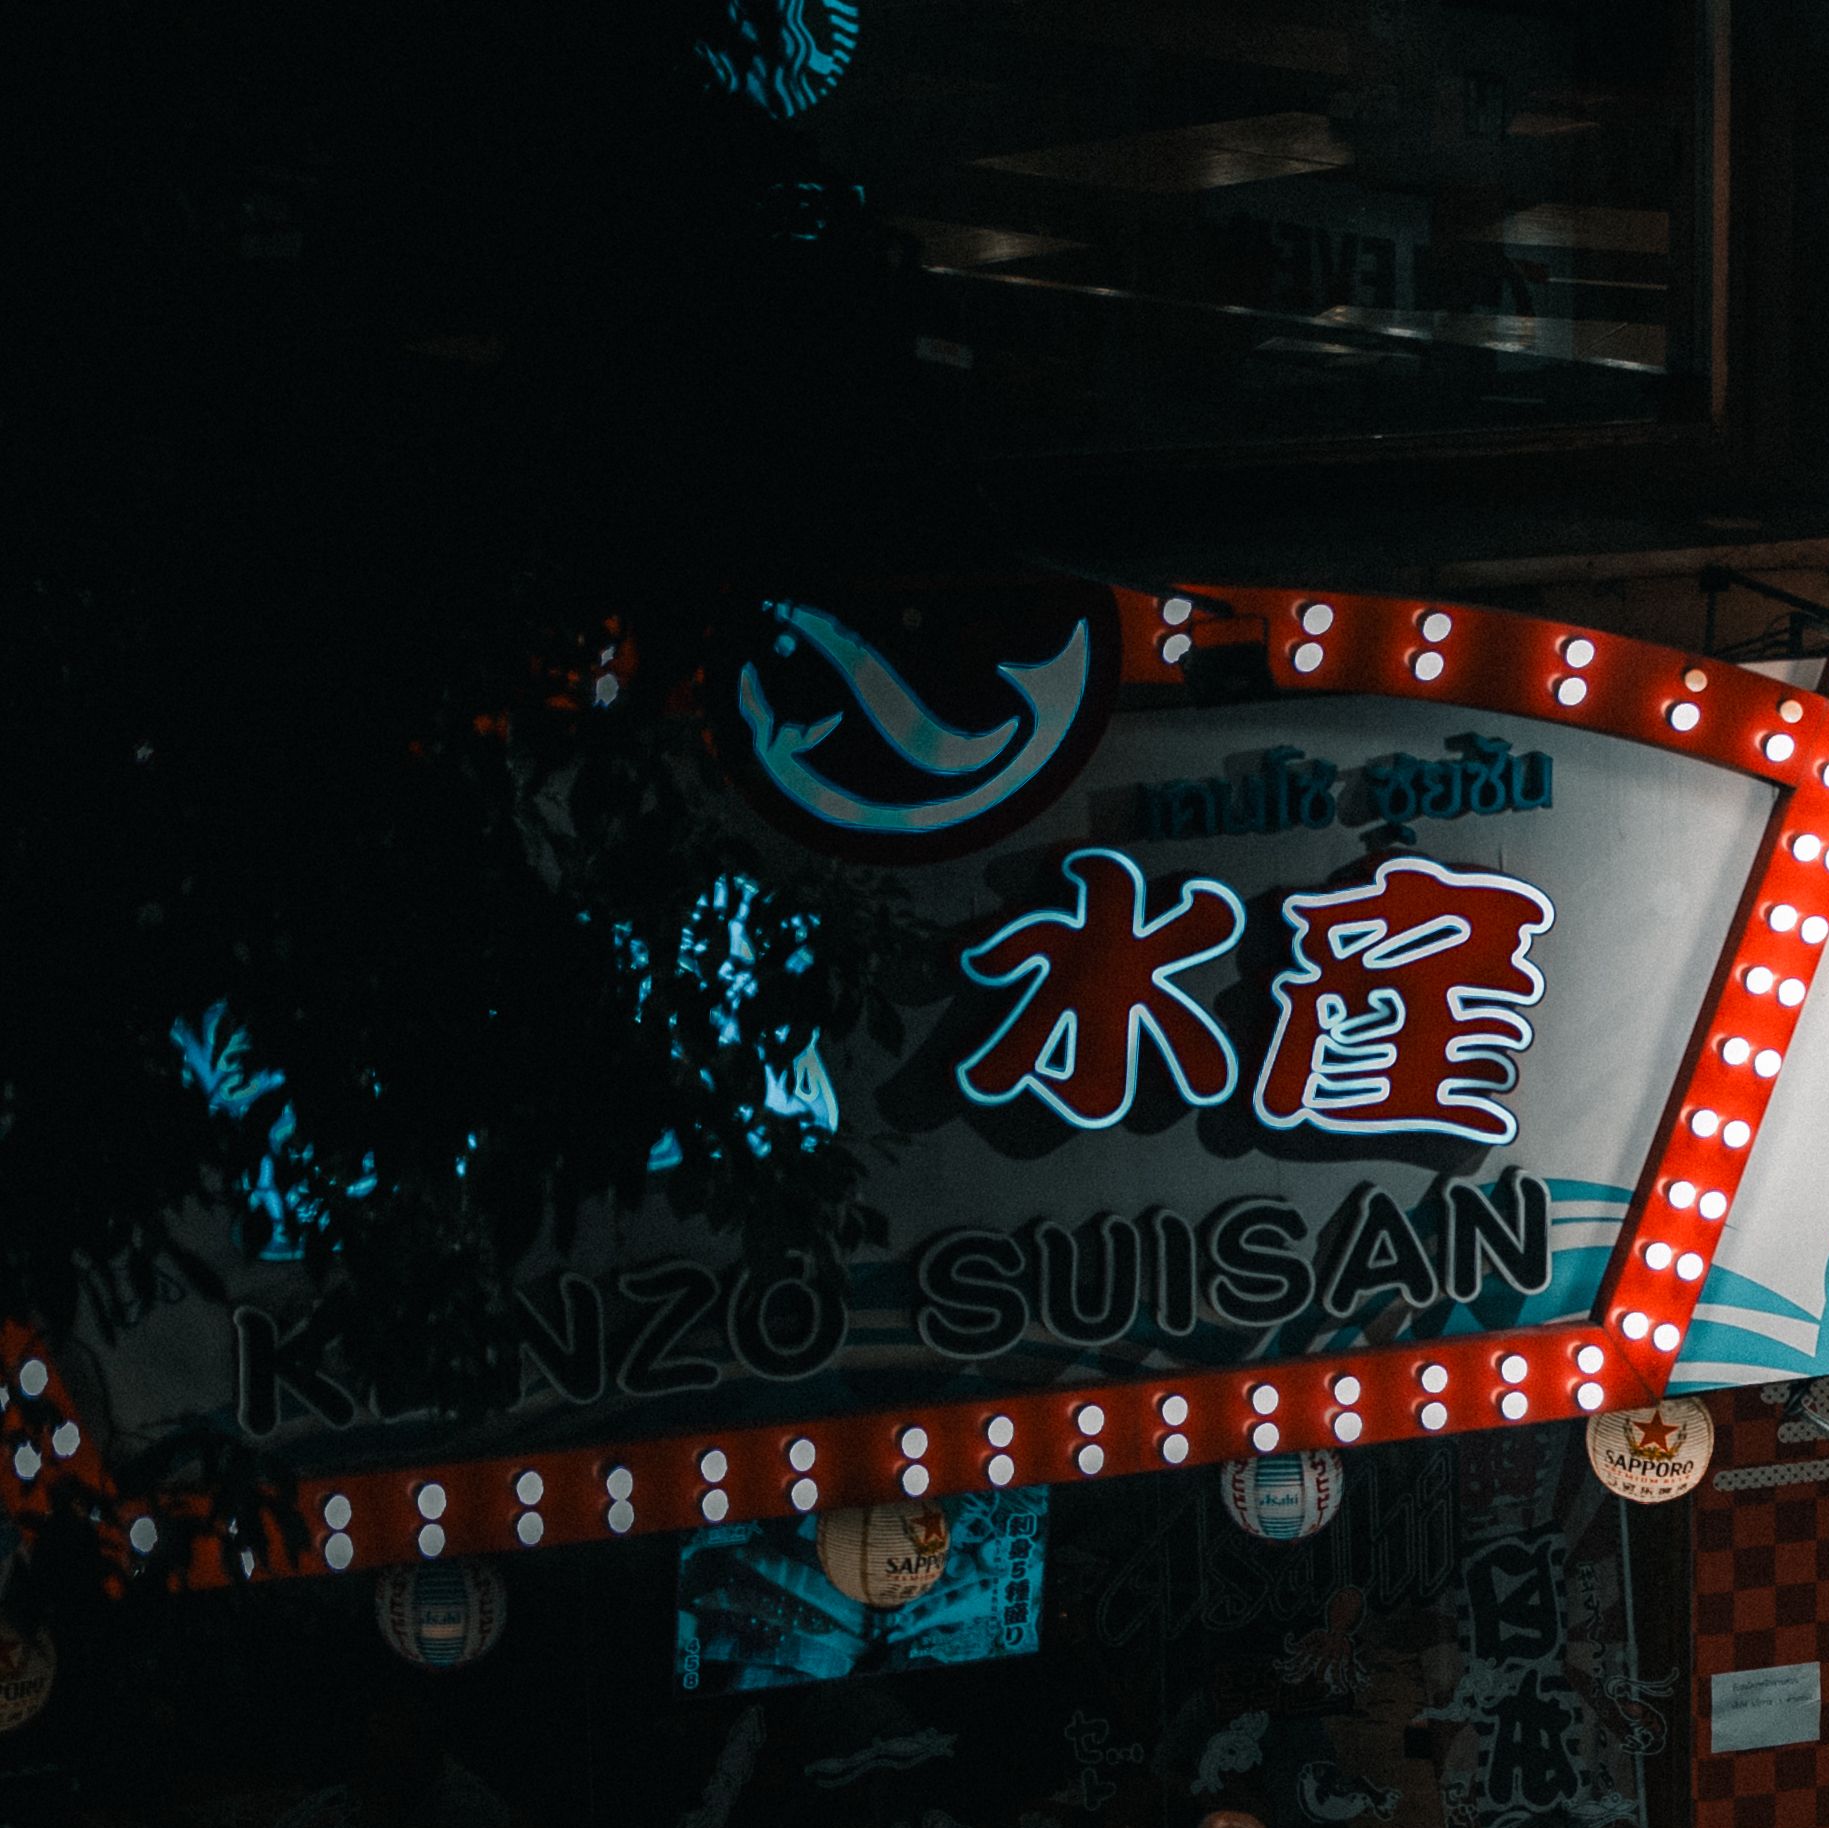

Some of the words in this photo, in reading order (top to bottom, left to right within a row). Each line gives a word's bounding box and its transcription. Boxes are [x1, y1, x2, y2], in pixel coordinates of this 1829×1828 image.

[954, 846, 1555, 1145] 水産
[914, 1167, 1553, 1358] SUISAN
[1605, 1449, 1694, 1477] SAPPORO
